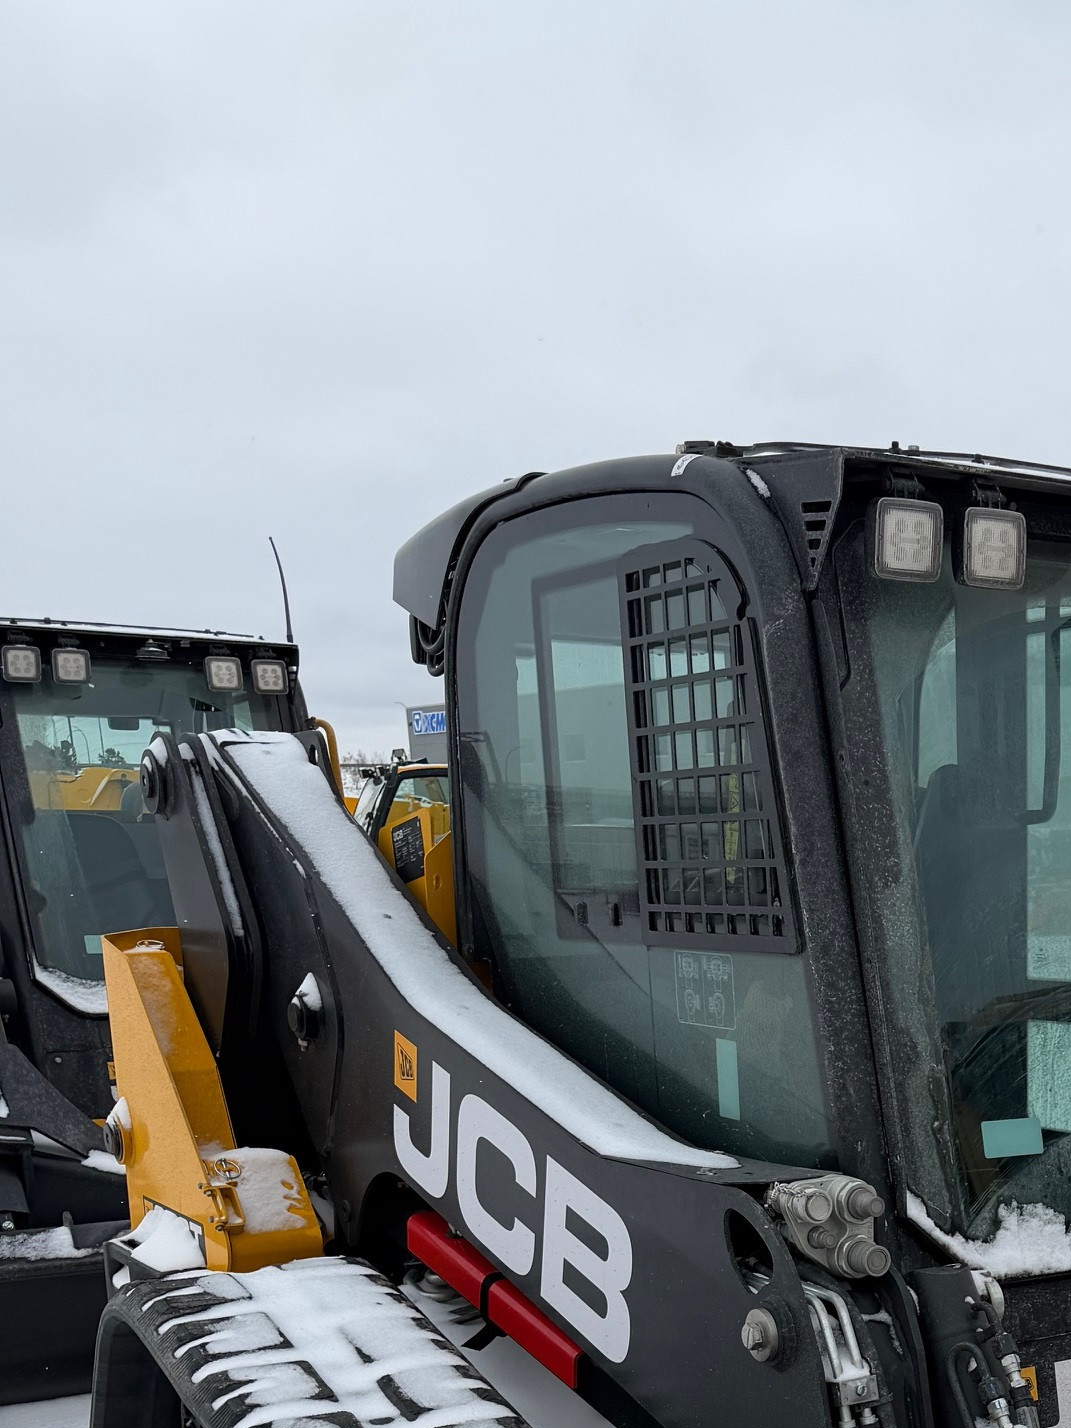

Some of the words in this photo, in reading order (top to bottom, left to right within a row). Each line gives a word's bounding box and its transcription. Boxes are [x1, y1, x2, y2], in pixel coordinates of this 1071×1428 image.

[423, 711, 446, 733] XCM
[400, 1048, 414, 1079] JCB
[393, 1060, 633, 1364] JCB
